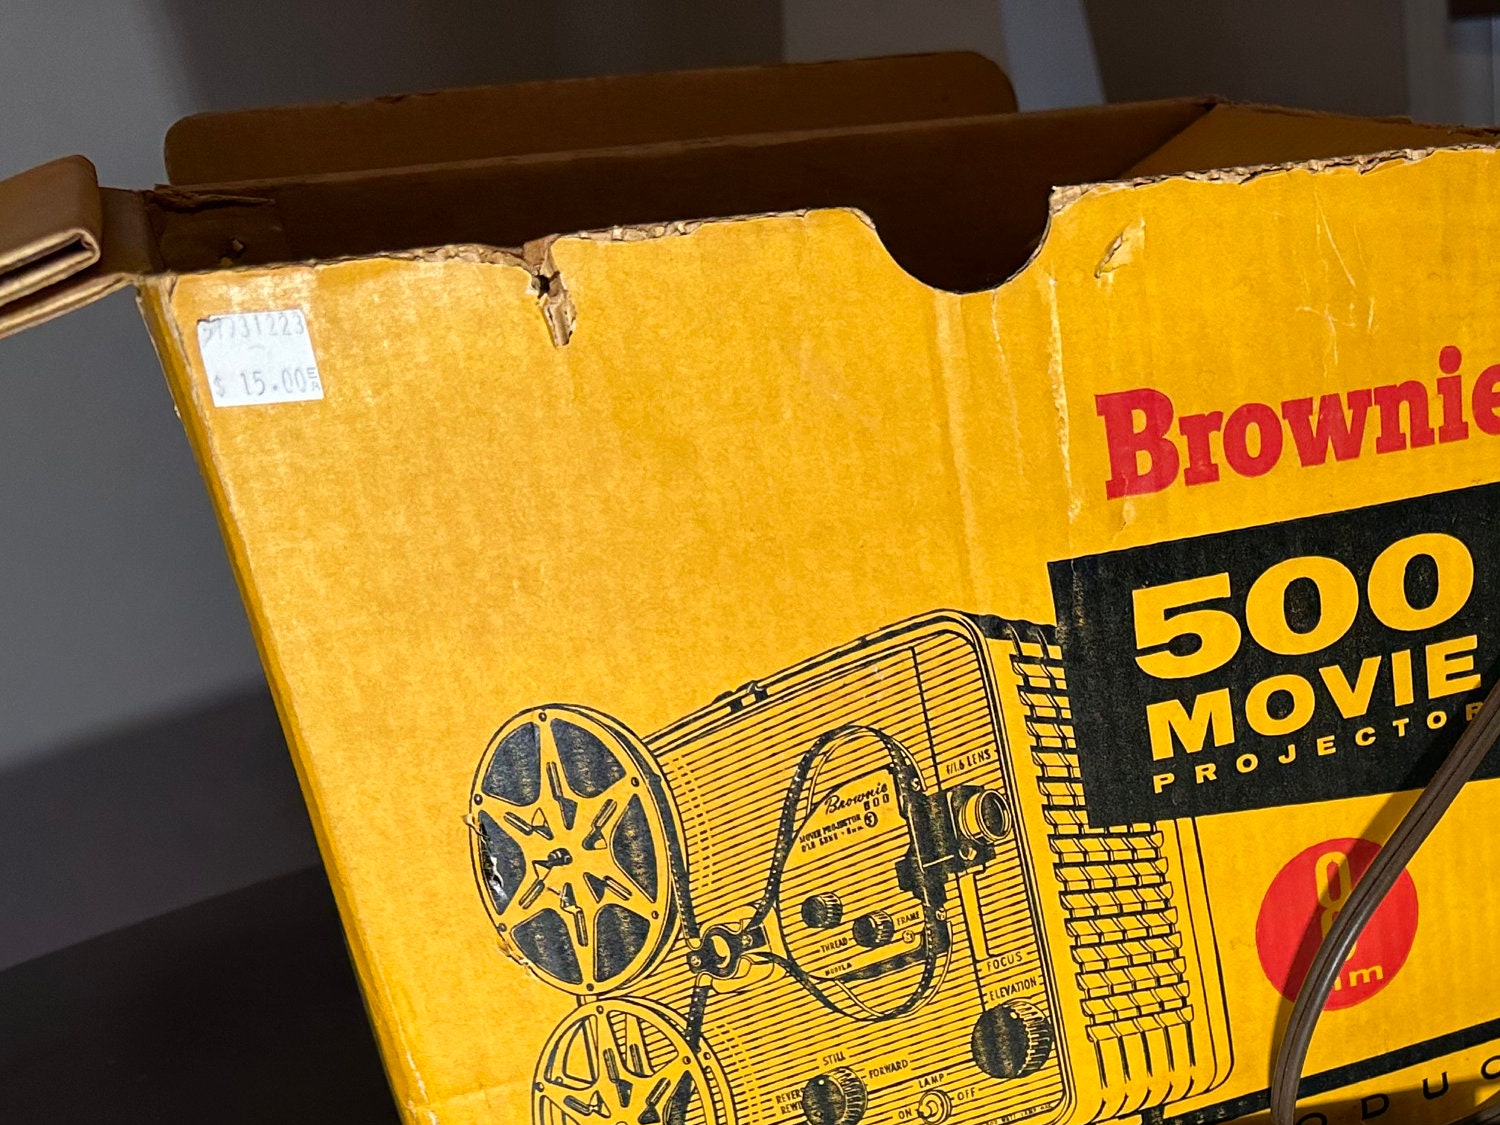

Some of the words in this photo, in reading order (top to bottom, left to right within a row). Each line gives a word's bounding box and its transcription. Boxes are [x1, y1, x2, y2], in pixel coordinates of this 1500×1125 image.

[1132, 532, 1474, 680] 500
[1146, 634, 1482, 762] MOVIE
[1152, 700, 1486, 794] PROJECTOR
[967, 749, 992, 767] LENS
[896, 911, 920, 926] FRAME
[820, 937, 848, 953] THREAD
[987, 952, 1023, 971] FOCUS
[989, 975, 1038, 1001] ELEVATION
[868, 1059, 909, 1080] FORWARD
[918, 1072, 945, 1088] LAMP
[957, 1087, 976, 1101] OFF
[898, 1107, 913, 1120] ON
